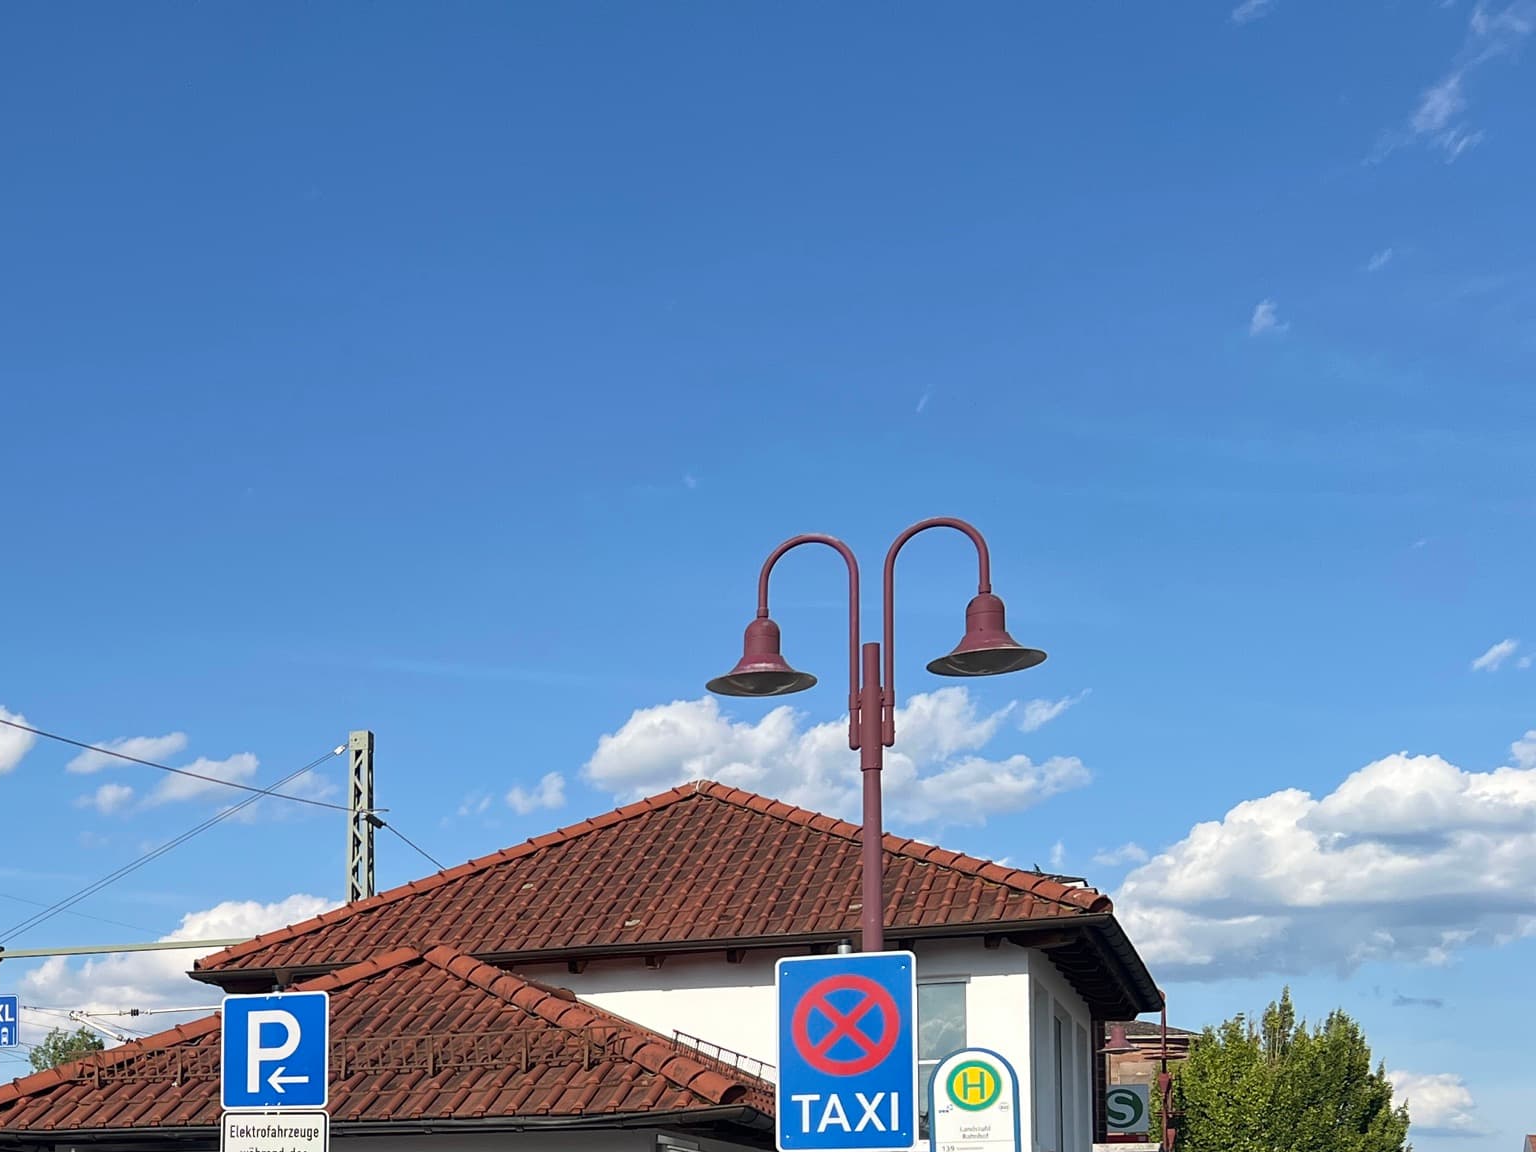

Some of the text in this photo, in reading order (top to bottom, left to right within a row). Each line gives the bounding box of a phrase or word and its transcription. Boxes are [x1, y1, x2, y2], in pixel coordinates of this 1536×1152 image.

[247, 1010, 301, 1094] P
[962, 1071, 985, 1100] H
[791, 1092, 899, 1133] TAXI
[230, 1125, 319, 1141] Elektrofahrzeuge
